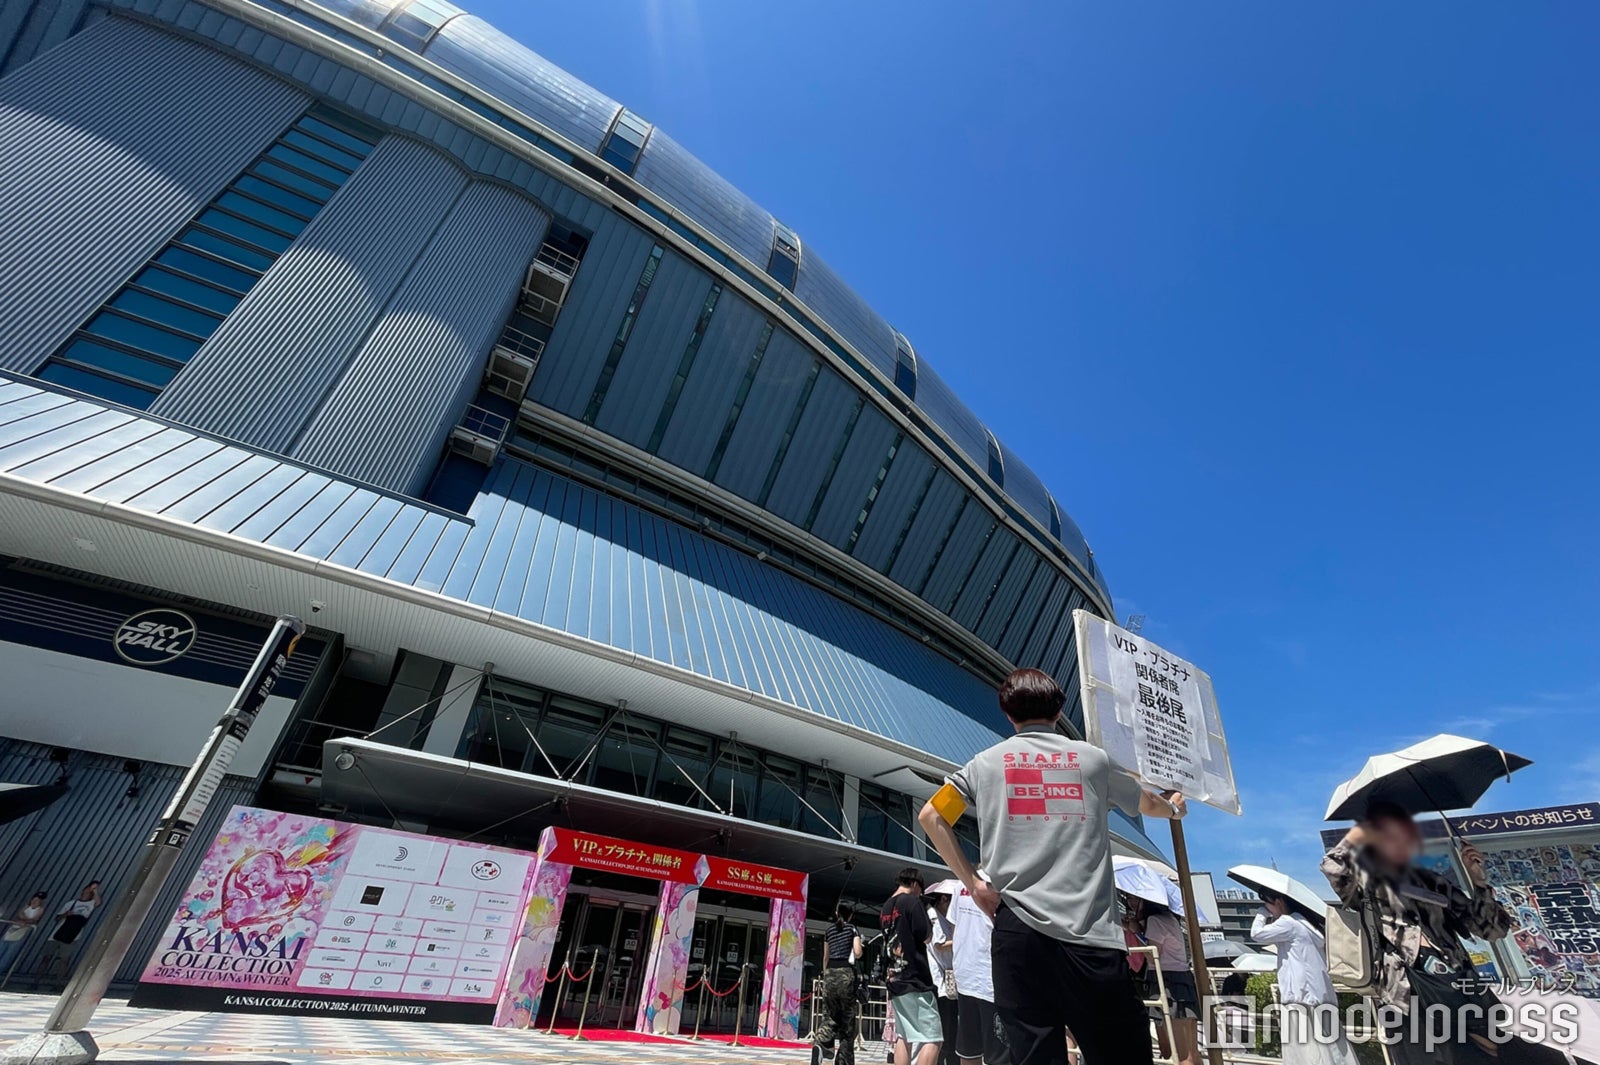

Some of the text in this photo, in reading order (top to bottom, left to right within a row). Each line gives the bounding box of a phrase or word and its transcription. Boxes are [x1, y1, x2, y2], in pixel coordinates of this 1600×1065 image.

[117, 631, 182, 655] HALL
[136, 621, 182, 640] SKY
[1134, 661, 1180, 696] 関係者席
[1137, 682, 1187, 724] 最後尾
[1003, 752, 1078, 763] STAFF
[1458, 807, 1594, 833] イベントのお知らせ
[167, 925, 309, 960] KANSAI
[160, 950, 298, 976] COLLECTION
[153, 967, 291, 986] 2025 AUTUMN&WINTER
[224, 995, 427, 1015] KANSAI COLLECTION 2025 AUTUMN&WINTER
